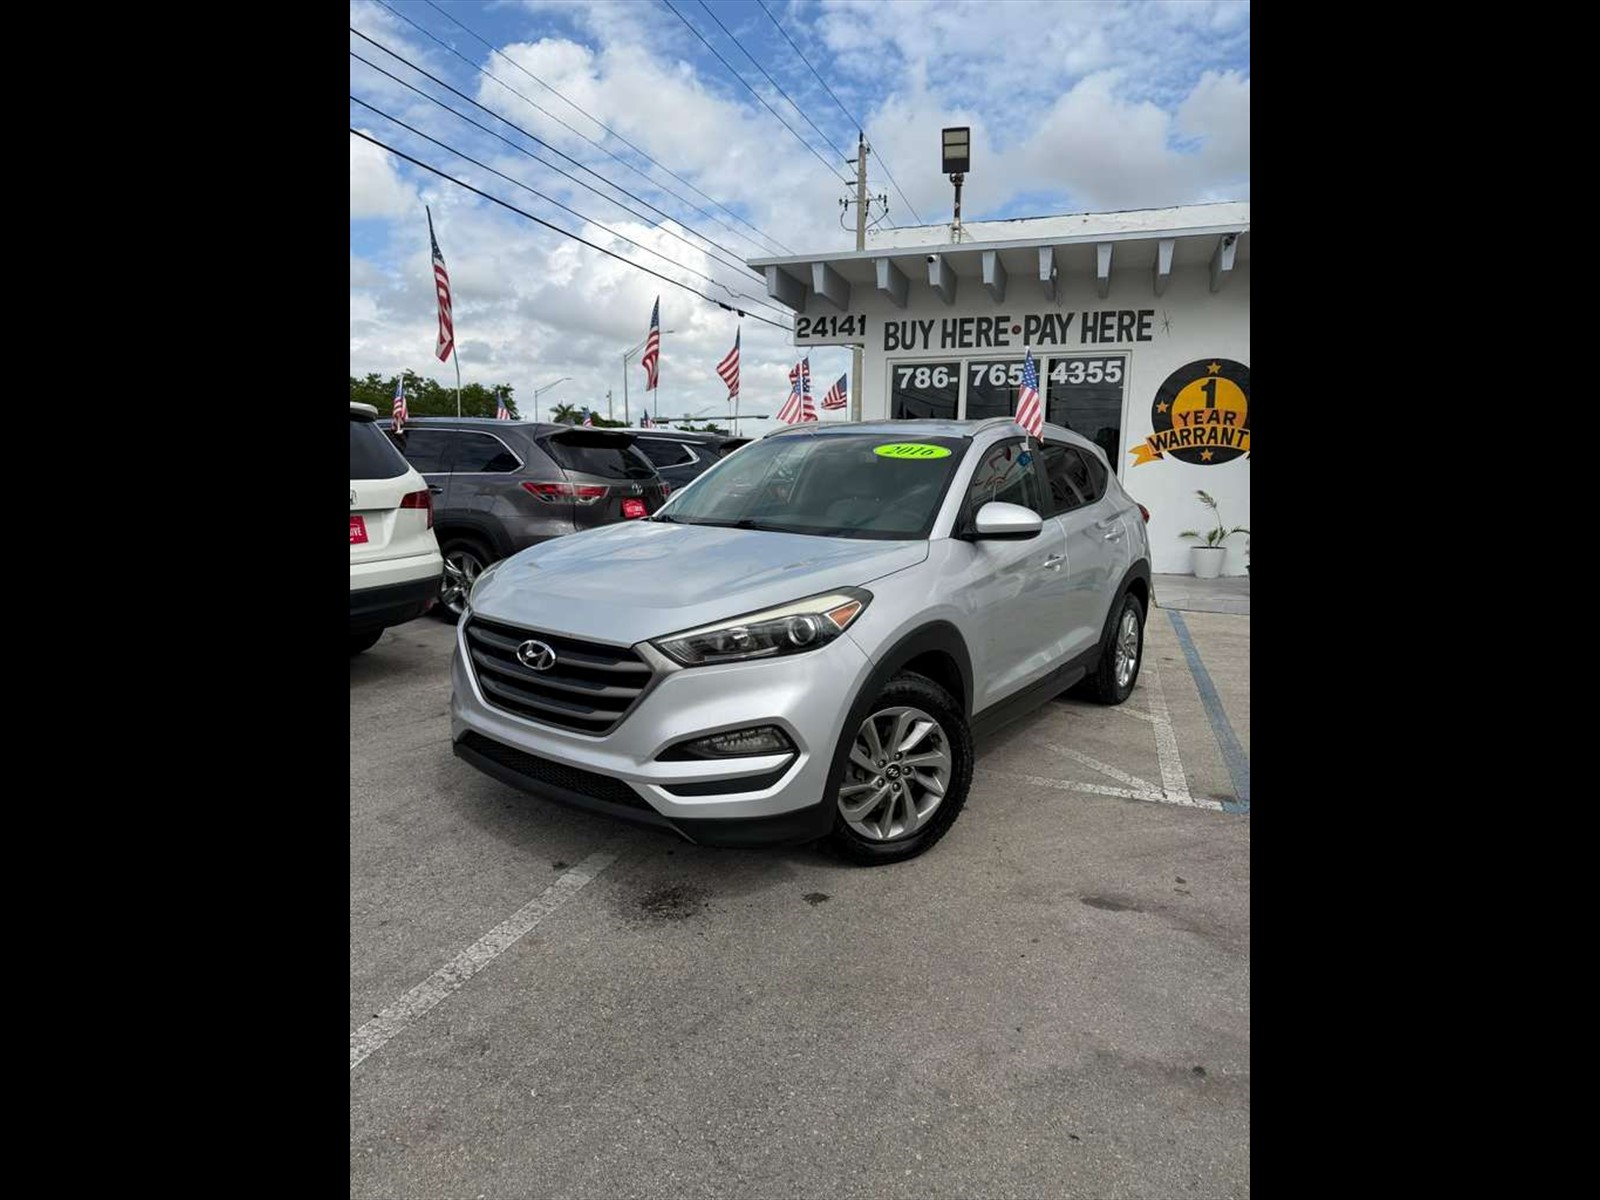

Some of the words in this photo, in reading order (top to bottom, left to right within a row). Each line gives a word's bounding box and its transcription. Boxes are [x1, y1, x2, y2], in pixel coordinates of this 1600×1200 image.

[796, 314, 867, 339] 24141
[884, 319, 935, 351] BUY
[941, 316, 1011, 349] HERE
[1023, 312, 1075, 346] PAY
[1081, 309, 1155, 344] HERE
[898, 366, 959, 389] 786-
[1050, 360, 1122, 385] 4355
[1201, 378, 1217, 409] 1
[1178, 409, 1237, 427] YEAR
[883, 445, 935, 457] 2016
